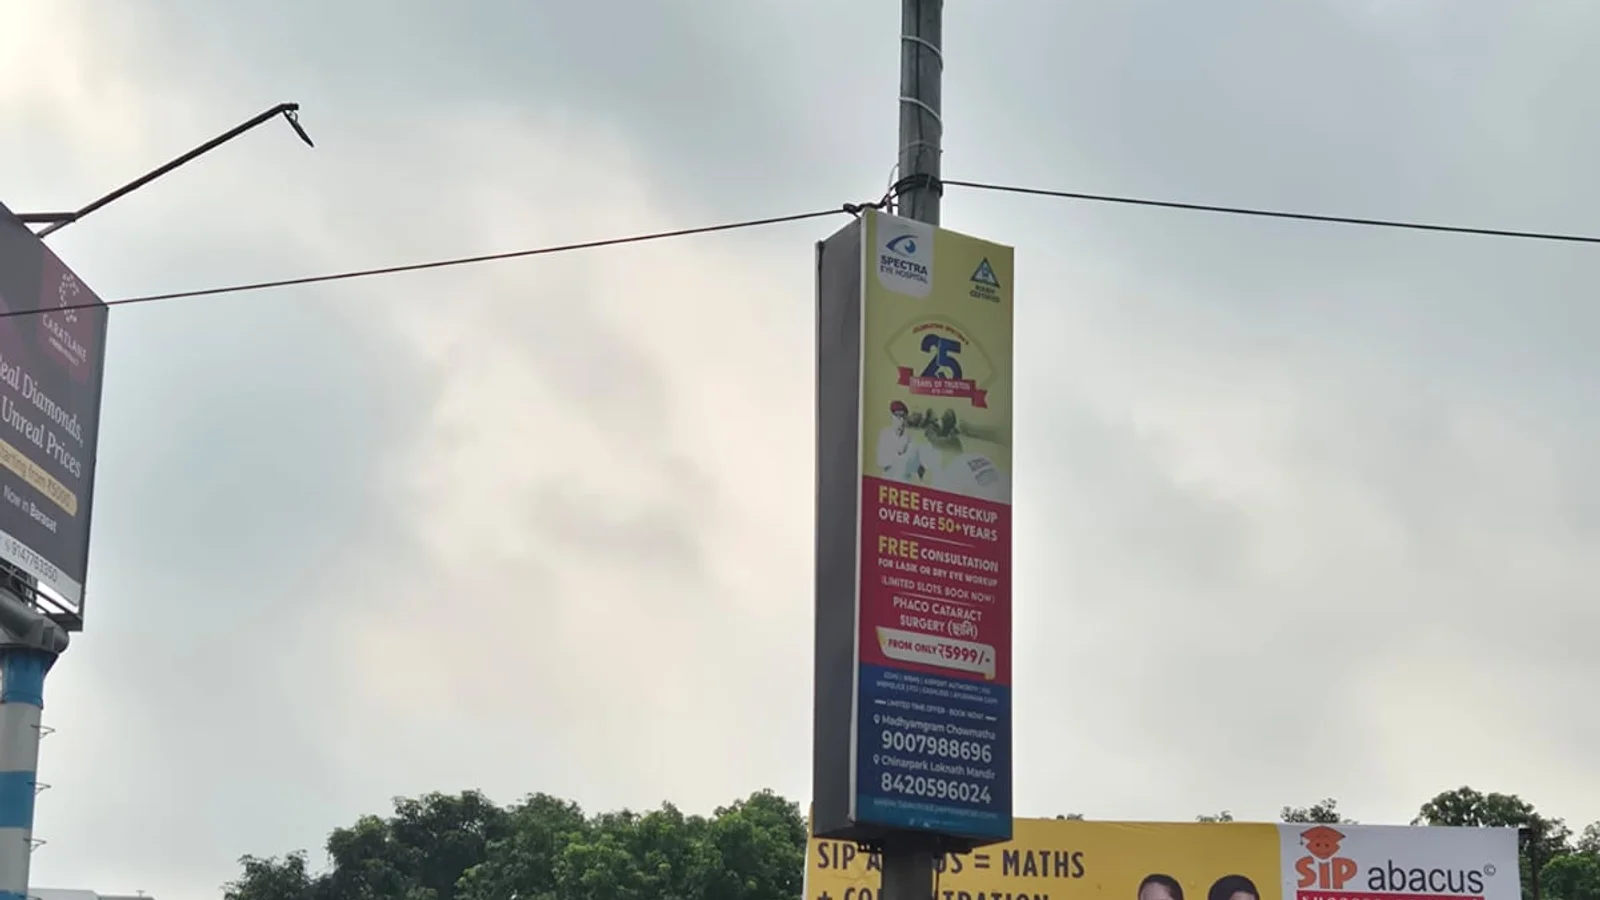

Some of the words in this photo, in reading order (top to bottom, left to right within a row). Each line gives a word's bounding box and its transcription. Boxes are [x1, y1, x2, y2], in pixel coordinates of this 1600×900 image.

[880, 255, 928, 276] SPECTRA
[880, 265, 895, 275] EYE
[895, 268, 928, 284] HOSPITAL
[920, 334, 963, 379] 25
[0, 354, 20, 391] eal
[2, 396, 45, 448] Unreal
[46, 431, 82, 478] Prices
[878, 485, 920, 511] FREE
[922, 498, 944, 514] EYE
[946, 502, 998, 524] CHECKUP
[878, 507, 910, 525] OVER
[912, 515, 936, 530] AGE
[878, 535, 919, 560] FREE
[920, 548, 999, 573] CONSULTATION
[878, 557, 894, 568] FOR
[895, 560, 919, 574] LASIK
[919, 565, 931, 576] OR
[932, 567, 948, 579] DRY
[949, 570, 964, 582] EYE
[965, 573, 998, 587] WORKUP
[945, 586, 969, 599] BOOK
[893, 596, 929, 612] PHACO
[932, 604, 982, 621] CATARACT
[900, 615, 945, 632] SURGERY
[888, 638, 912, 650] FROM
[914, 643, 937, 655] ONLY
[882, 714, 945, 733] Madhyamgram
[881, 730, 992, 762] 9007988696
[881, 754, 929, 772] Chinarpark
[930, 762, 965, 776] Loknath
[881, 772, 992, 804] 8420596024
[818, 841, 856, 870] SIP
[1002, 850, 1085, 878] MATHS
